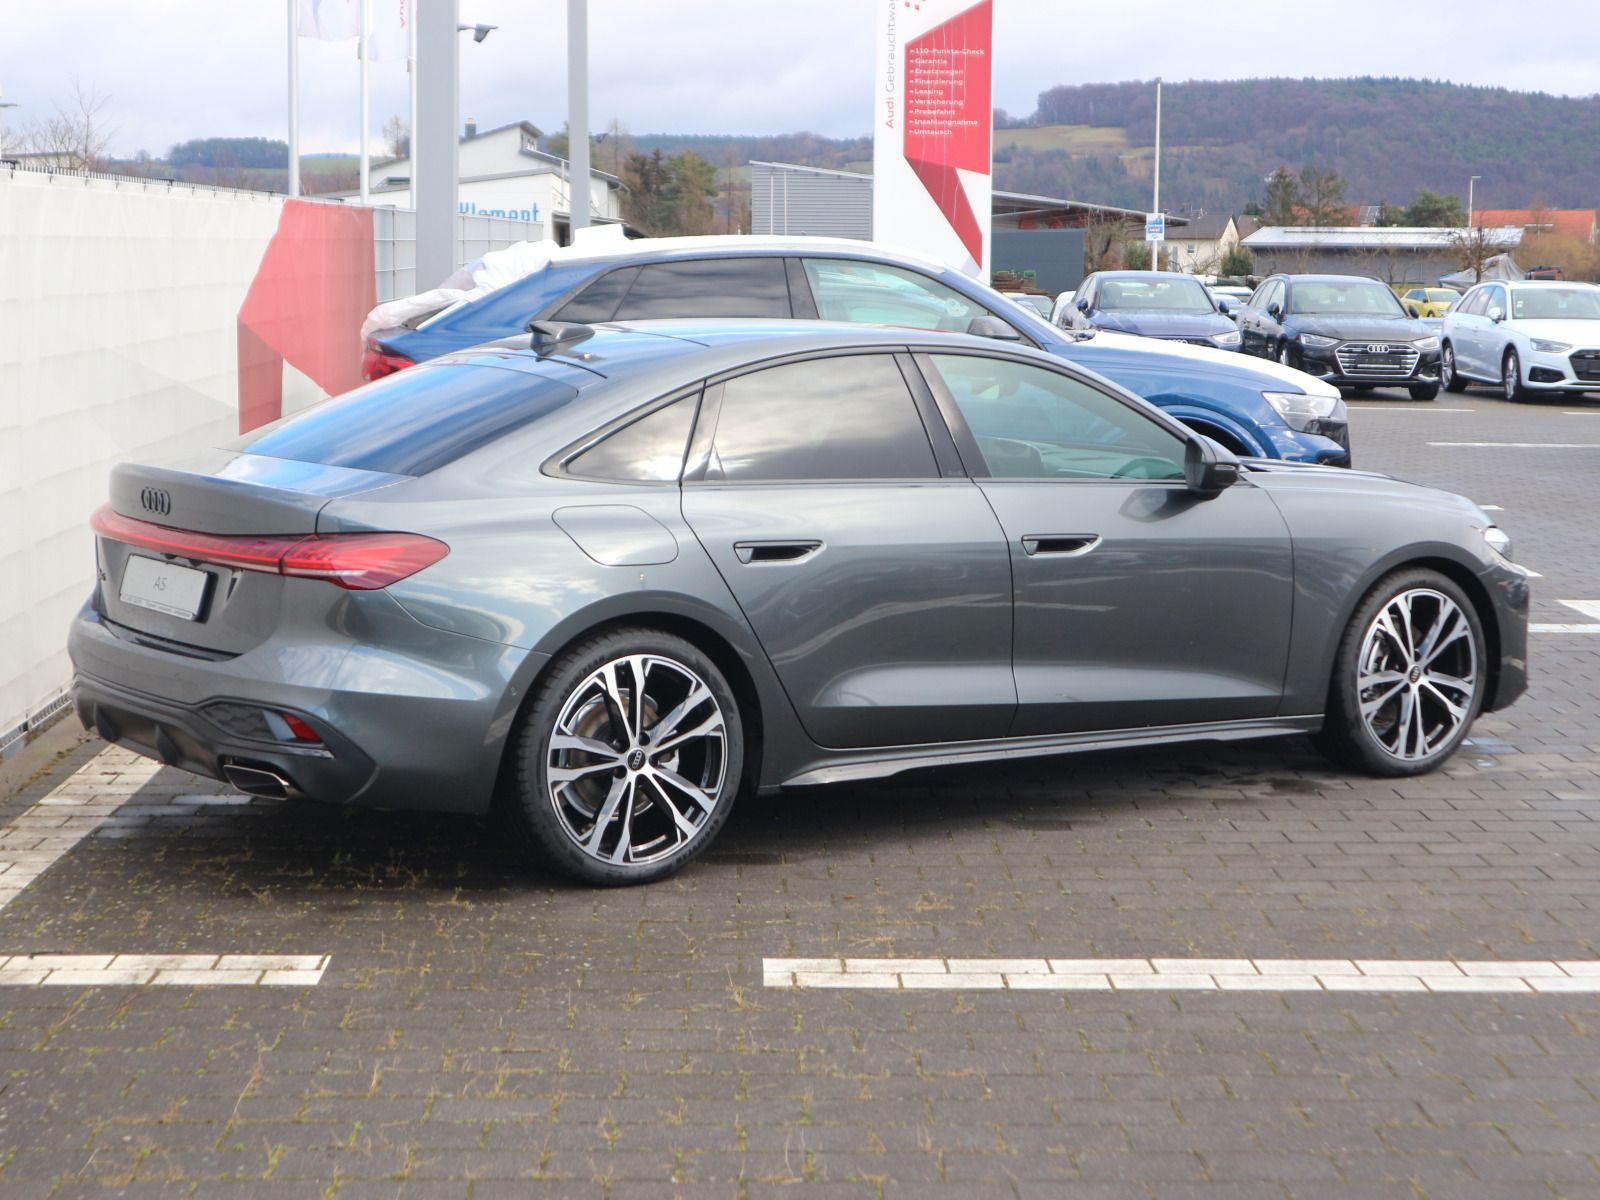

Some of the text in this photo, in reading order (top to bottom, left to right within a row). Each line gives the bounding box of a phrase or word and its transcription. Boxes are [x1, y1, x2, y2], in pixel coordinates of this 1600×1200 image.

[885, 0, 896, 129] Audi Gebrauchtwa
[914, 57, 947, 65] Garantie
[914, 68, 964, 76] Ersatzwagen
[914, 78, 963, 86] Finanzierung
[914, 88, 944, 96] Leasing
[914, 98, 964, 106] Versicherung
[914, 108, 956, 116] Probefahrt
[913, 118, 979, 127] Inzahlungnahme
[913, 128, 953, 136] Umtausch
[153, 576, 168, 592] A5
